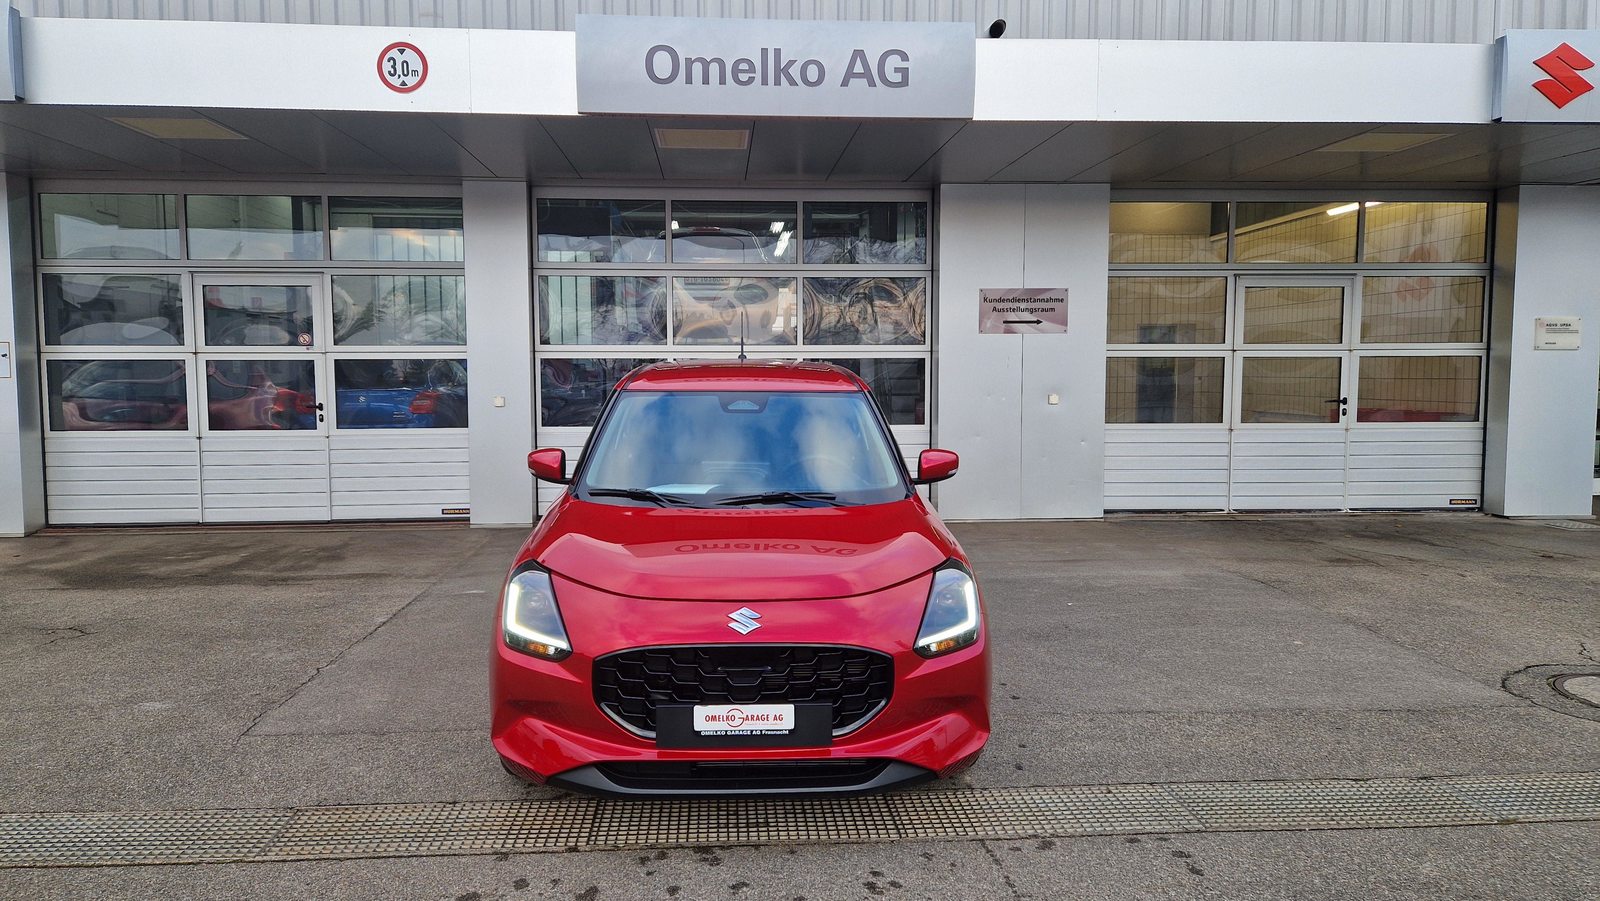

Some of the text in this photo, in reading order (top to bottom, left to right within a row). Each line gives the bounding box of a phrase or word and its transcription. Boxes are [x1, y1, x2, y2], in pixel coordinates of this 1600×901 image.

[645, 44, 910, 88] Omelko AG
[983, 296, 1065, 304] Kundendienstannahme
[991, 306, 1056, 315] Ausstellungsraum
[704, 714, 736, 722] OMELKO
[773, 714, 784, 722] AG
